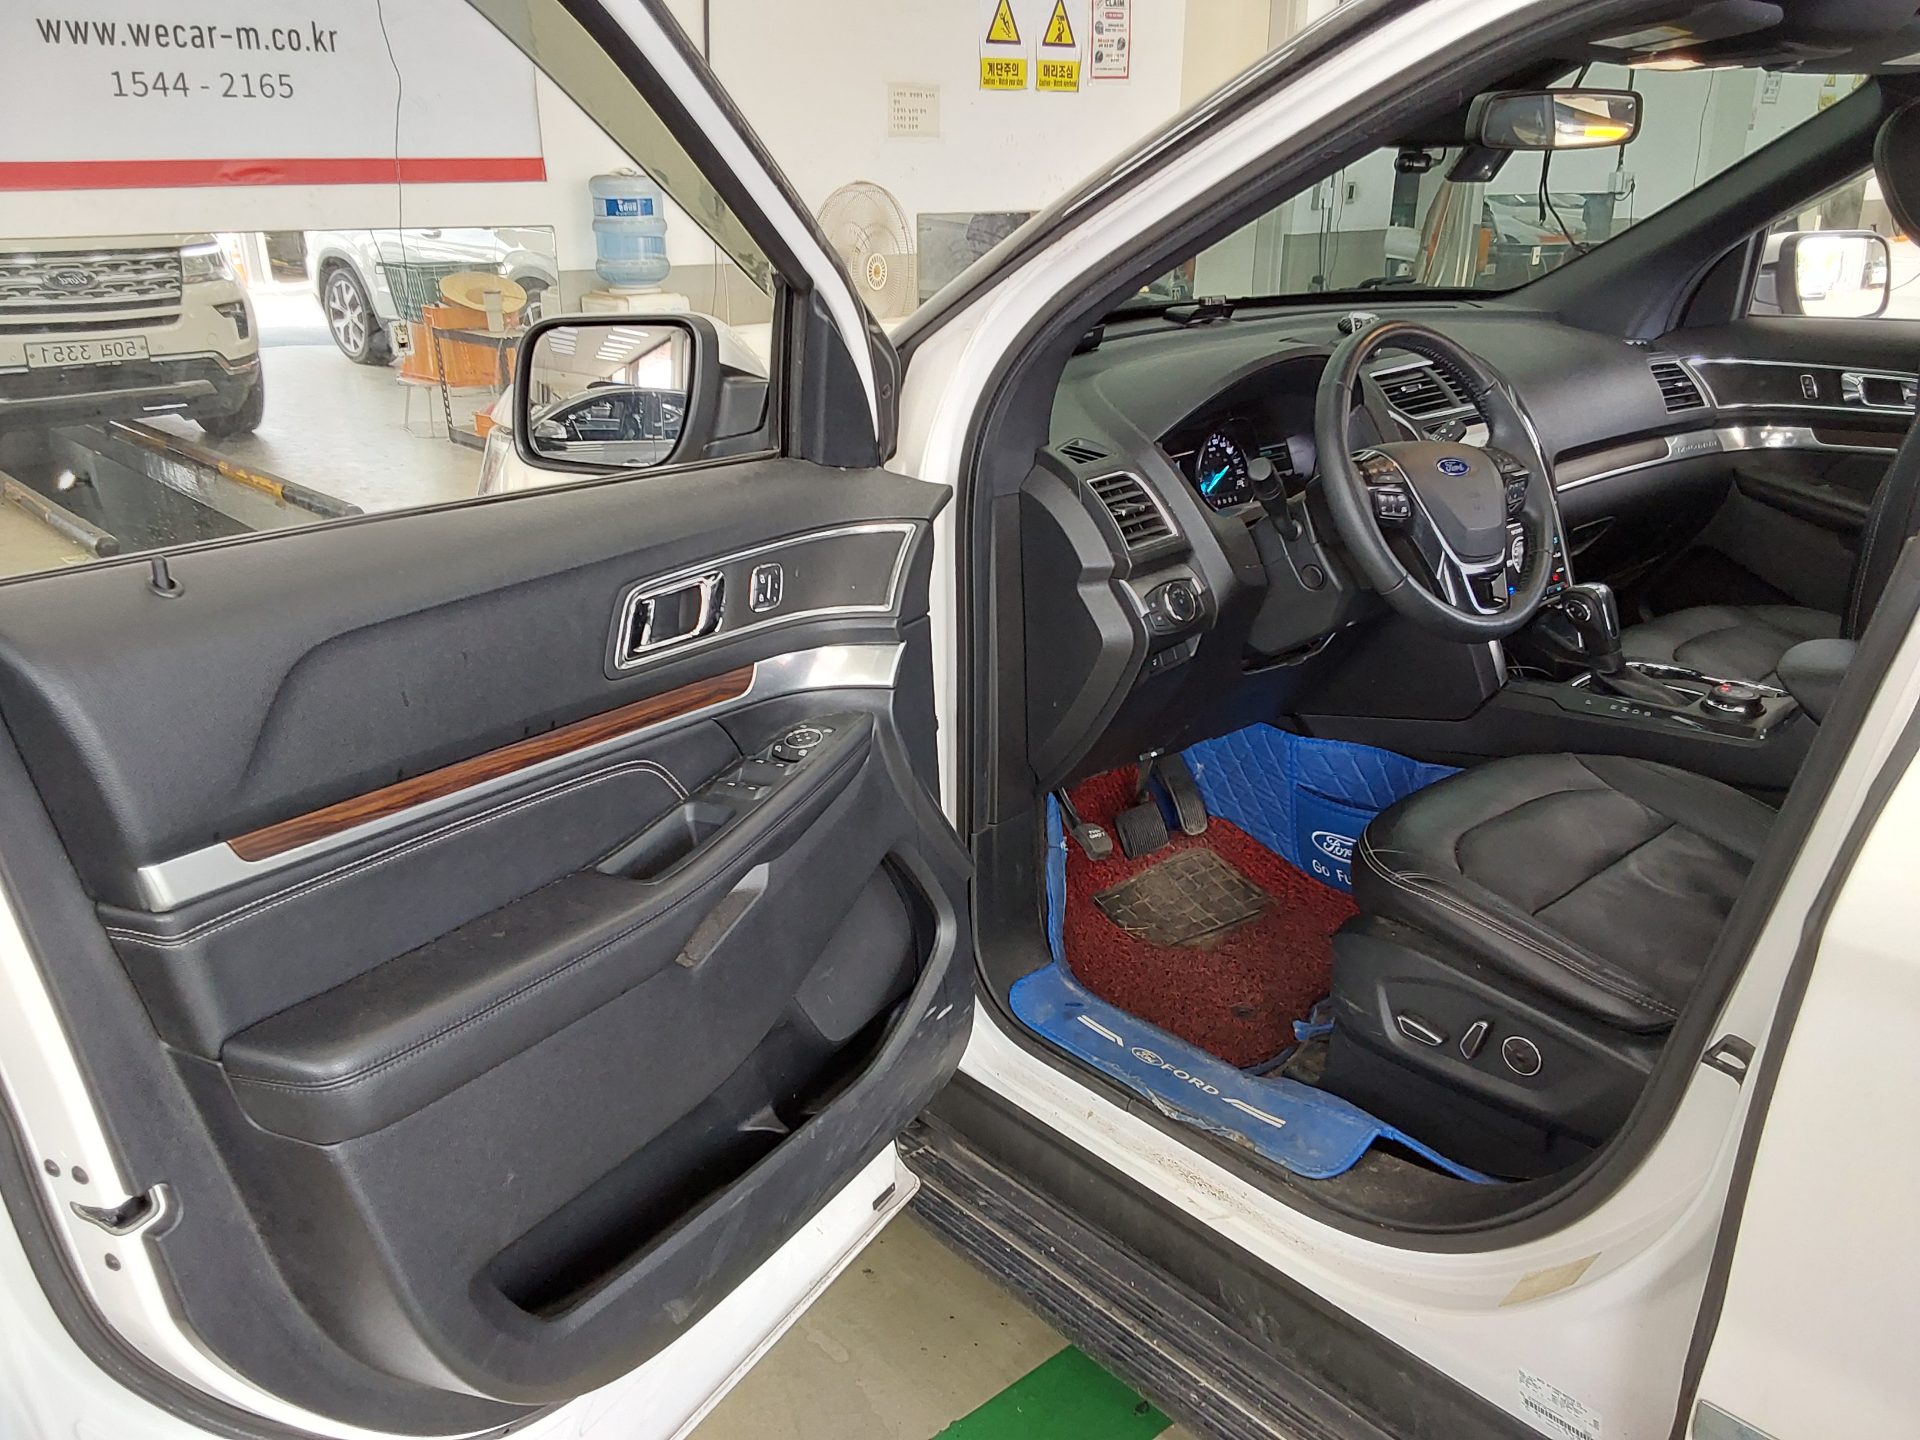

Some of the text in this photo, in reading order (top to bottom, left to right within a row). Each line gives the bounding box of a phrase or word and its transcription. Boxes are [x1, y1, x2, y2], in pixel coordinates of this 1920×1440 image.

[36, 18, 338, 53] www.wecar-m.co.kr
[987, 62, 1019, 77] 계단주의
[1043, 64, 1073, 79] 머리조심
[111, 71, 190, 97] 1544
[219, 72, 294, 99] 2165
[1160, 1063, 1219, 1095] FORD
